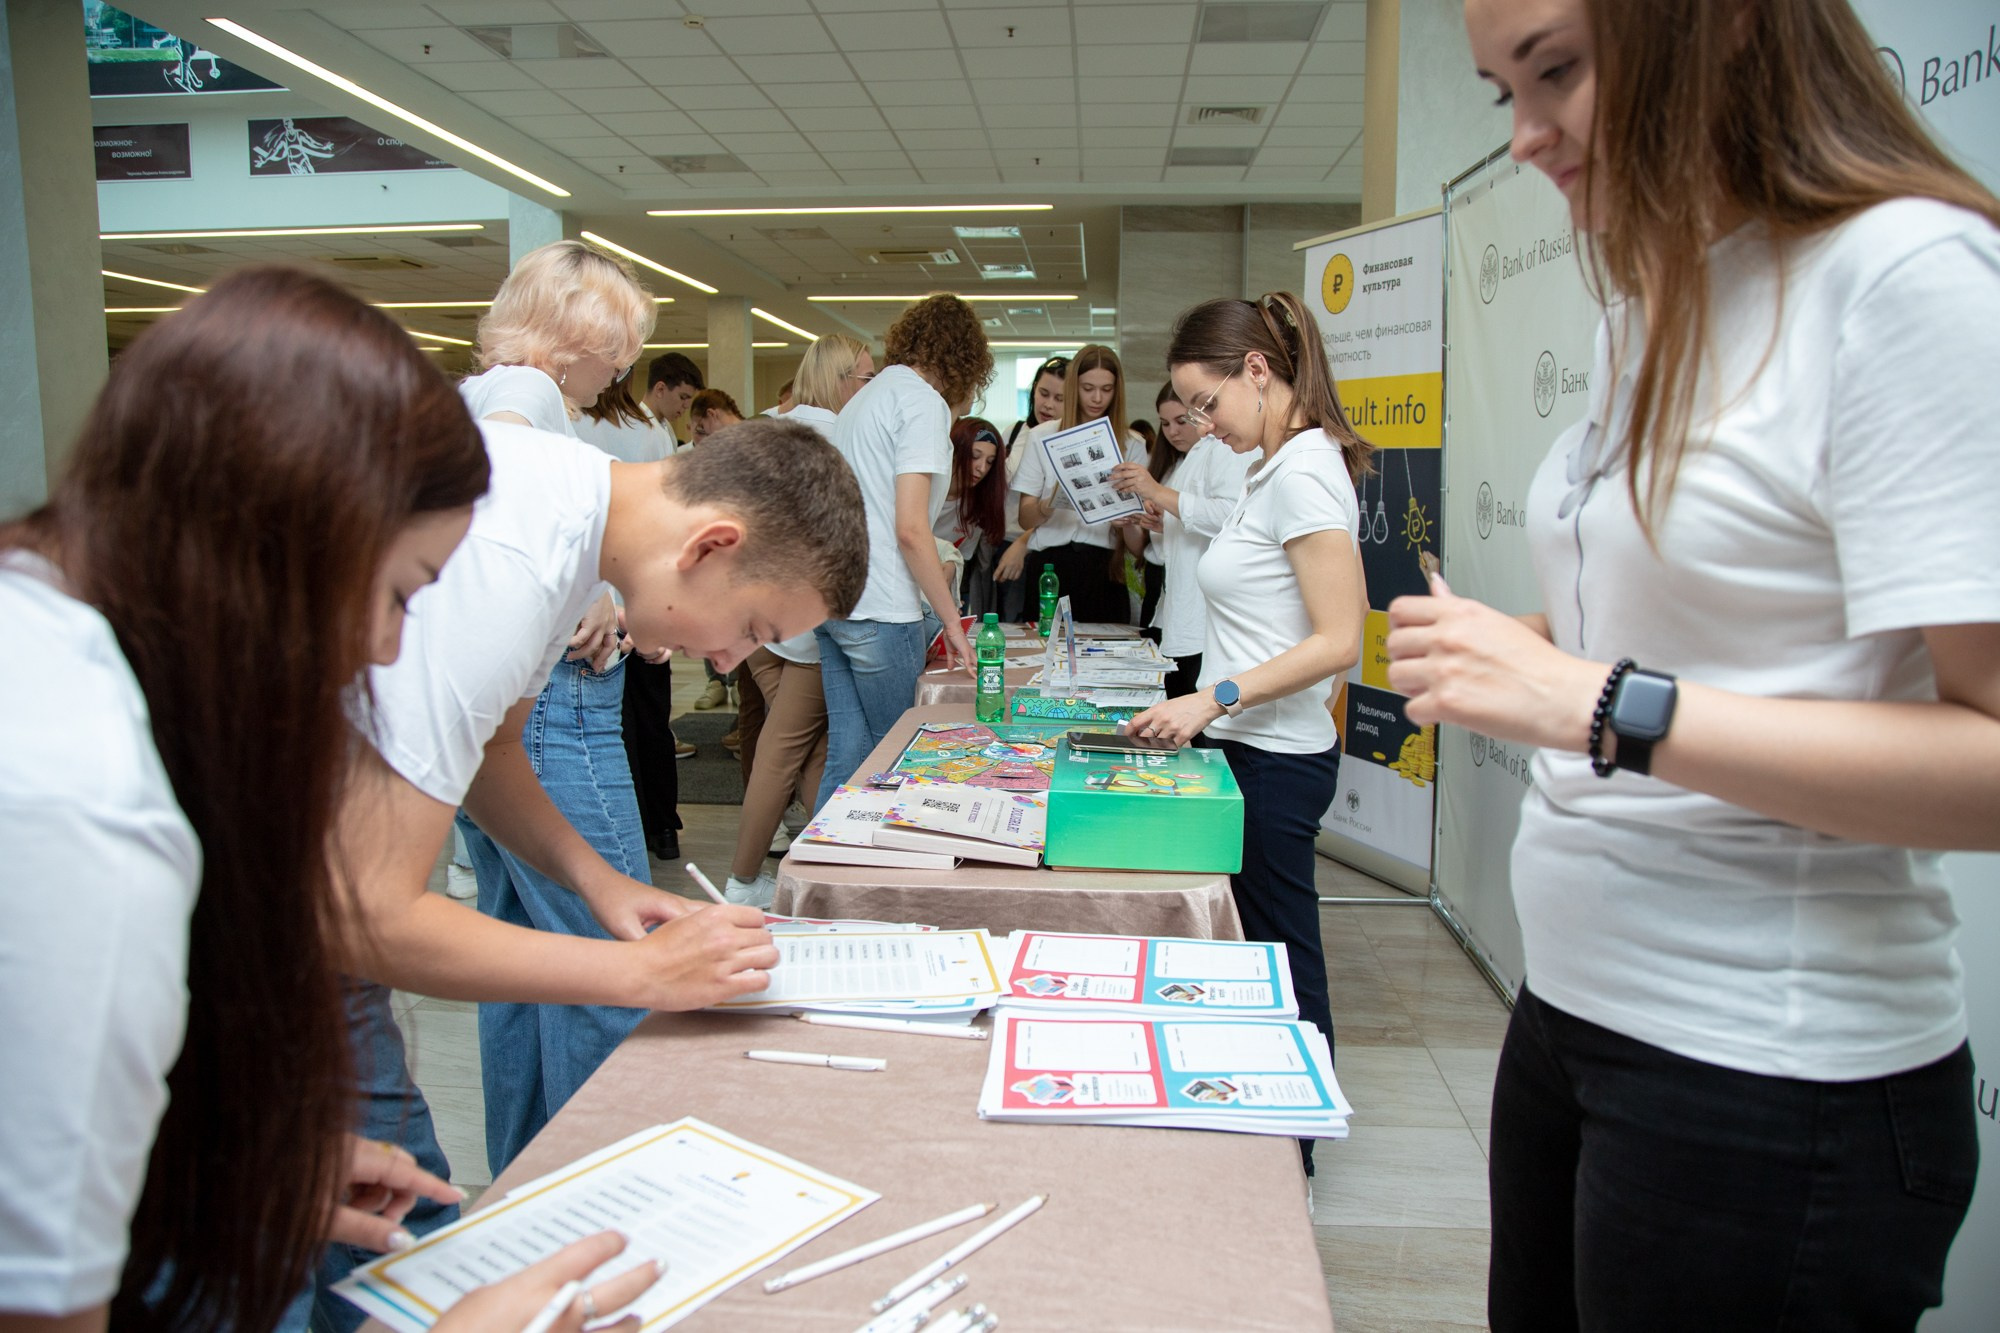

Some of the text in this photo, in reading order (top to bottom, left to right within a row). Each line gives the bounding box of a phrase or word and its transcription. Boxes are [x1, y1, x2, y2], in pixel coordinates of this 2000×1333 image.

[1920, 24, 2000, 106] Bank
[377, 137, 405, 147] О спор
[112, 149, 152, 158] возможно!
[1362, 256, 1413, 275] Финансовая
[1502, 229, 1572, 280] Bank of Russia
[1362, 277, 1401, 295] культура
[1355, 329, 1373, 341] чем
[1375, 319, 1432, 340] финансовая
[1561, 368, 1589, 395] Банк
[1343, 394, 1426, 427] ult.info
[1497, 501, 1526, 528] Bank o
[1357, 702, 1397, 723] Увеличить
[1356, 721, 1379, 737] доход
[1489, 737, 1508, 771] Bank
[1510, 753, 1520, 777] of
[1333, 810, 1372, 833] Банк России
